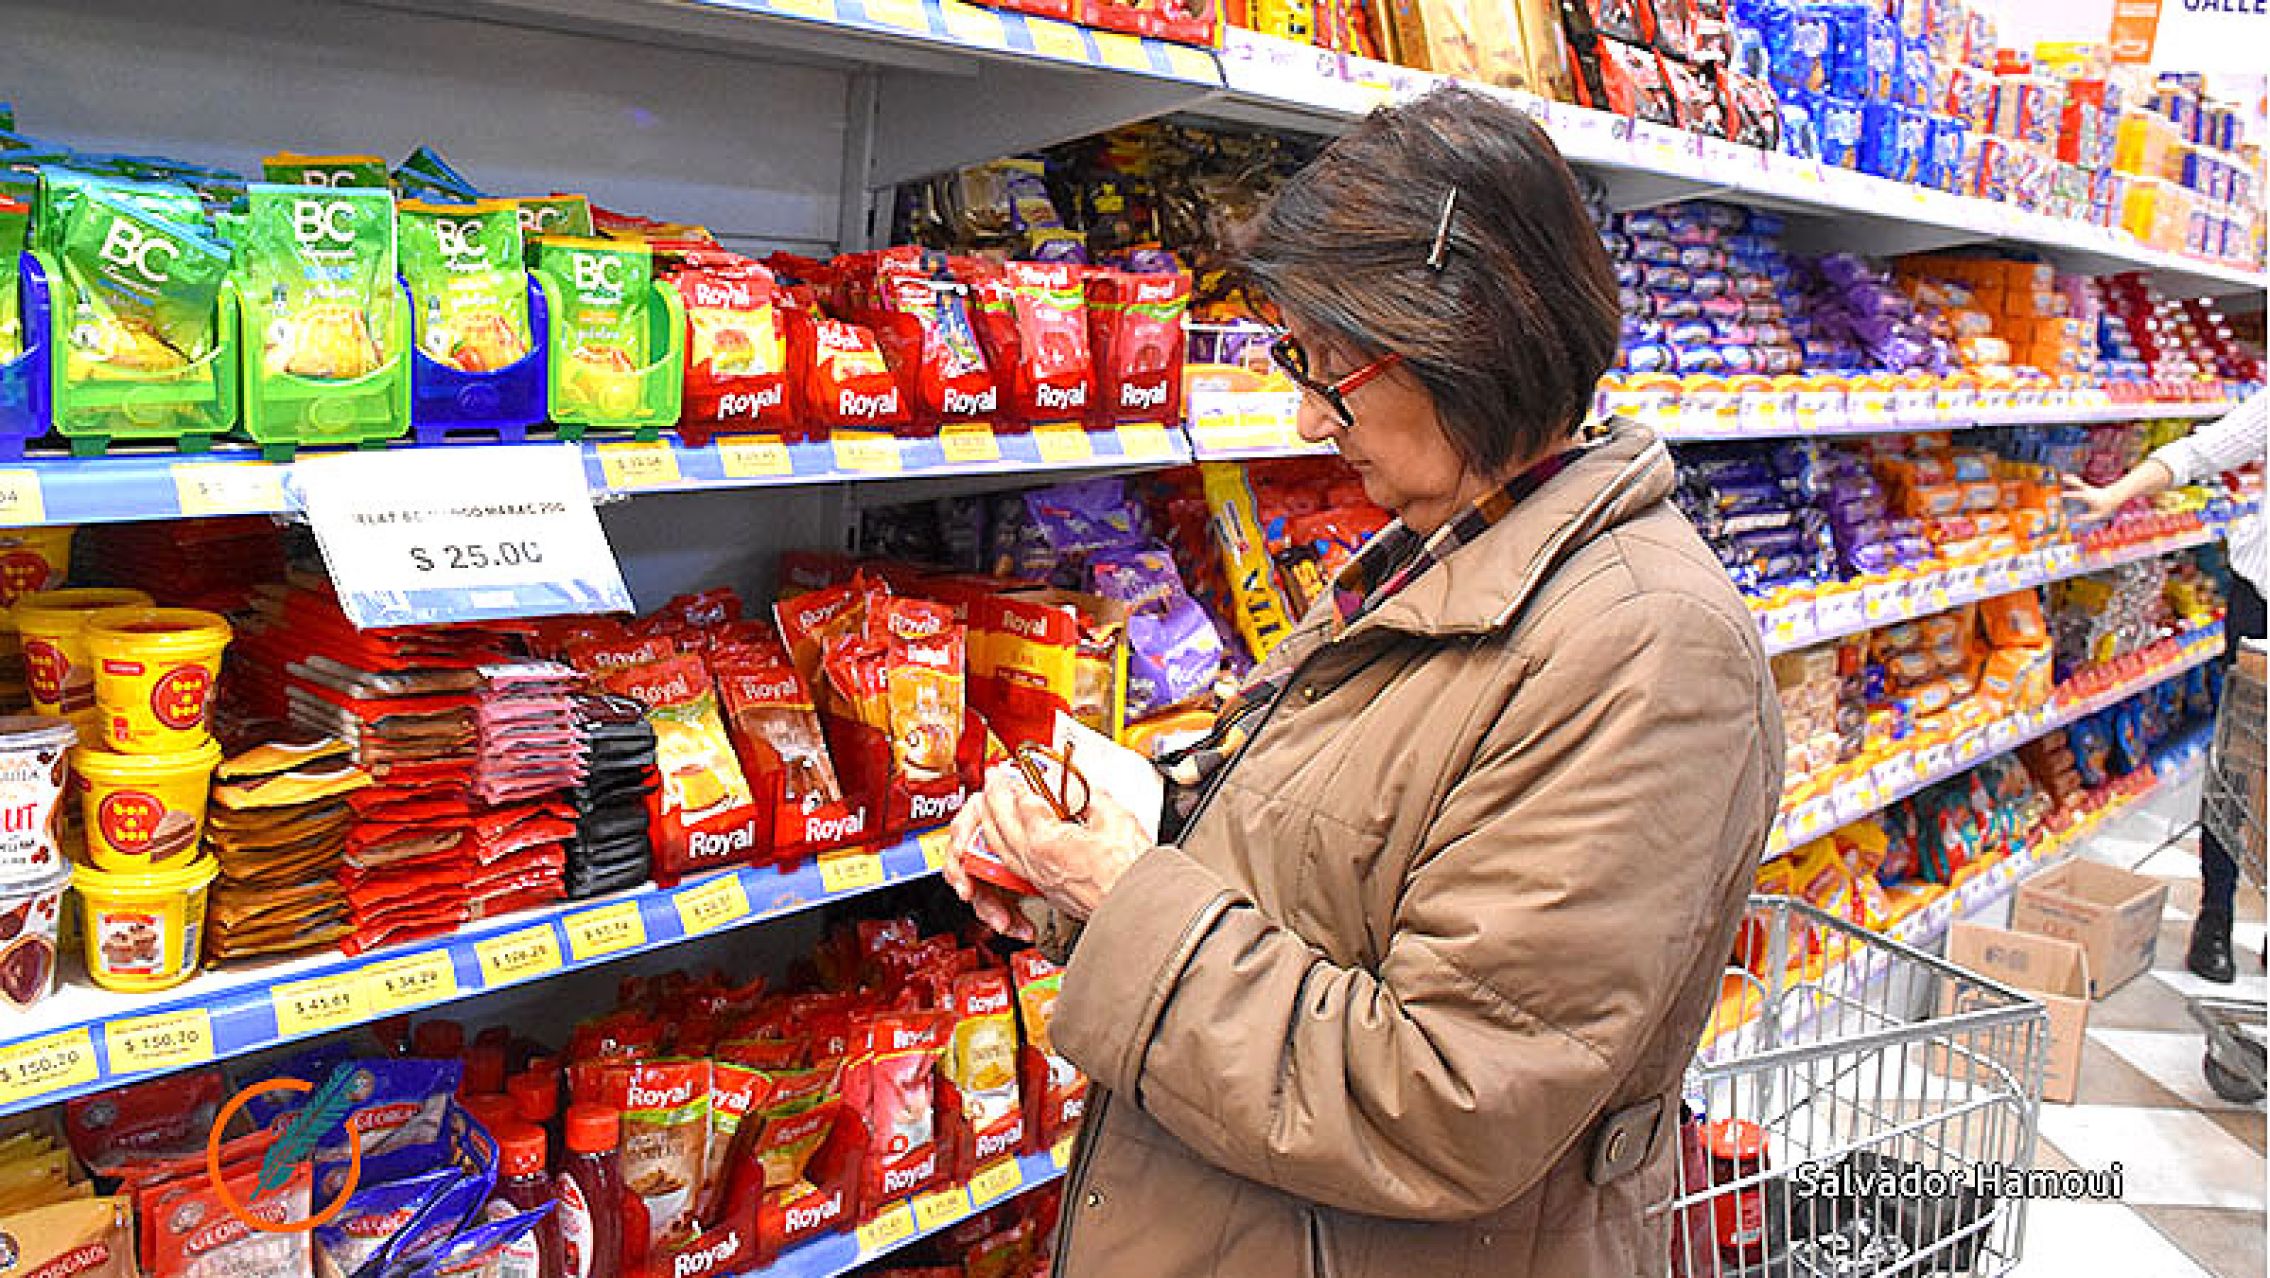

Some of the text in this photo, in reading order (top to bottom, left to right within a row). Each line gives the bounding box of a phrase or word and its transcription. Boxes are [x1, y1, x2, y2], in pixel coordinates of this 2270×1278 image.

[293, 201, 356, 242] BC
[98, 216, 180, 281] BC
[436, 219, 488, 256] BC
[572, 253, 623, 290] BC
[718, 384, 781, 420] Royal
[840, 387, 897, 420] Royal
[941, 386, 997, 415] Royal
[1036, 381, 1087, 409] Royal
[1120, 381, 1167, 409] Royal
[410, 547, 435, 571] $
[1003, 608, 1048, 638] Royal
[172, 677, 202, 695] bon
[181, 694, 193, 704] o
[170, 703, 200, 720] bon
[112, 802, 150, 816] bon
[910, 785, 967, 820] Royal
[3, 803, 39, 834] UT
[114, 826, 150, 842] bon
[125, 818, 138, 828] o
[805, 806, 865, 842] Royal
[689, 820, 755, 859] Royal
[626, 1080, 693, 1108] Royal
[711, 1087, 754, 1111] yal
[976, 1118, 1024, 1159] Royal
[883, 1152, 937, 1193] Royal
[785, 1190, 842, 1234] Royal
[674, 1231, 741, 1278] Royal
